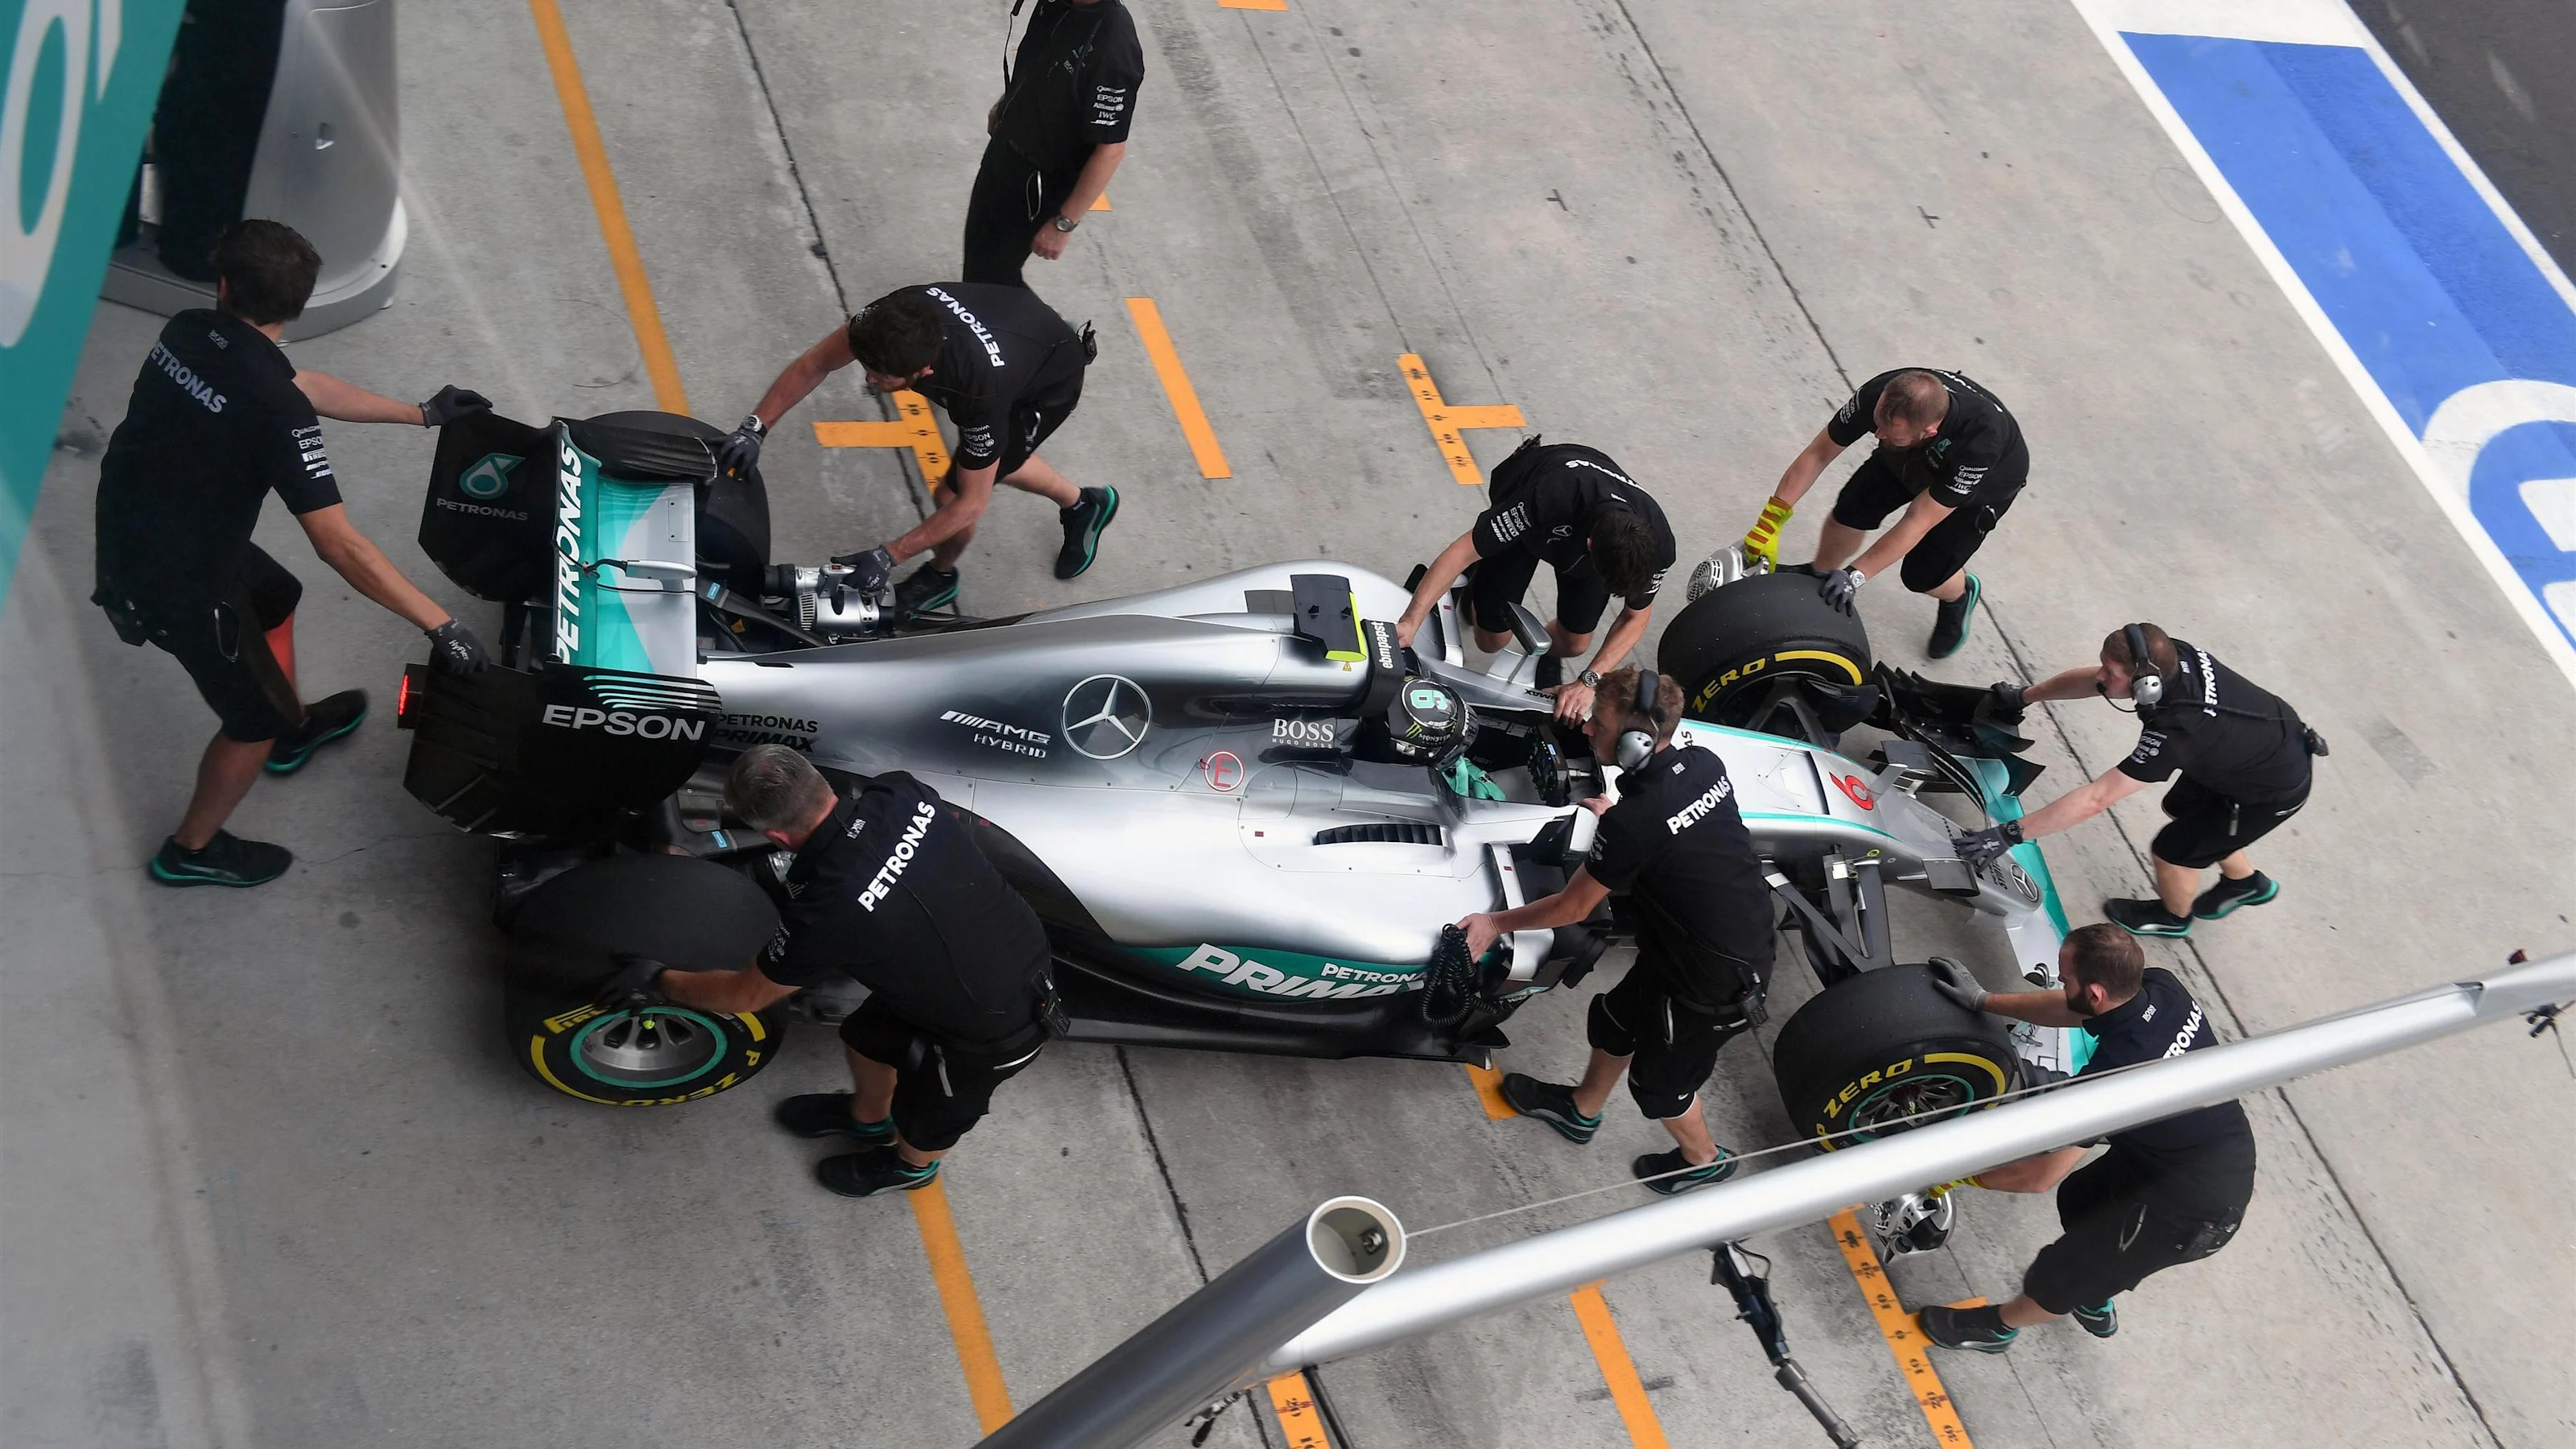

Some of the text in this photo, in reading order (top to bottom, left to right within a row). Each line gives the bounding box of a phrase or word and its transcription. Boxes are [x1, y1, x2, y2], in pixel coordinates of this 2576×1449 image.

[1096, 94, 1124, 103] EPSON
[1098, 111, 1117, 120] IWC
[927, 287, 1005, 367] PETRONAS
[298, 436, 323, 449] EPSO
[1959, 472, 1984, 480] EPSON
[436, 497, 529, 521] PETRONAS
[1510, 507, 1525, 531] EPSON
[556, 440, 582, 665] PETRONAS
[1371, 621, 1393, 670] ebmpapst
[1692, 658, 1766, 713] ZERO
[543, 704, 706, 741] EPSON
[719, 712, 818, 733] PETRONAS
[1273, 718, 1334, 742] BOSS
[973, 733, 1046, 758] HYBRID
[1666, 775, 1732, 835] PETRONAS
[1829, 770, 1875, 811] 6
[857, 801, 936, 912] PETRONAS
[1321, 963, 1428, 984] PETRONA
[2162, 1000, 2202, 1059] TRONAS
[1823, 1059, 1913, 1119] ZERO
